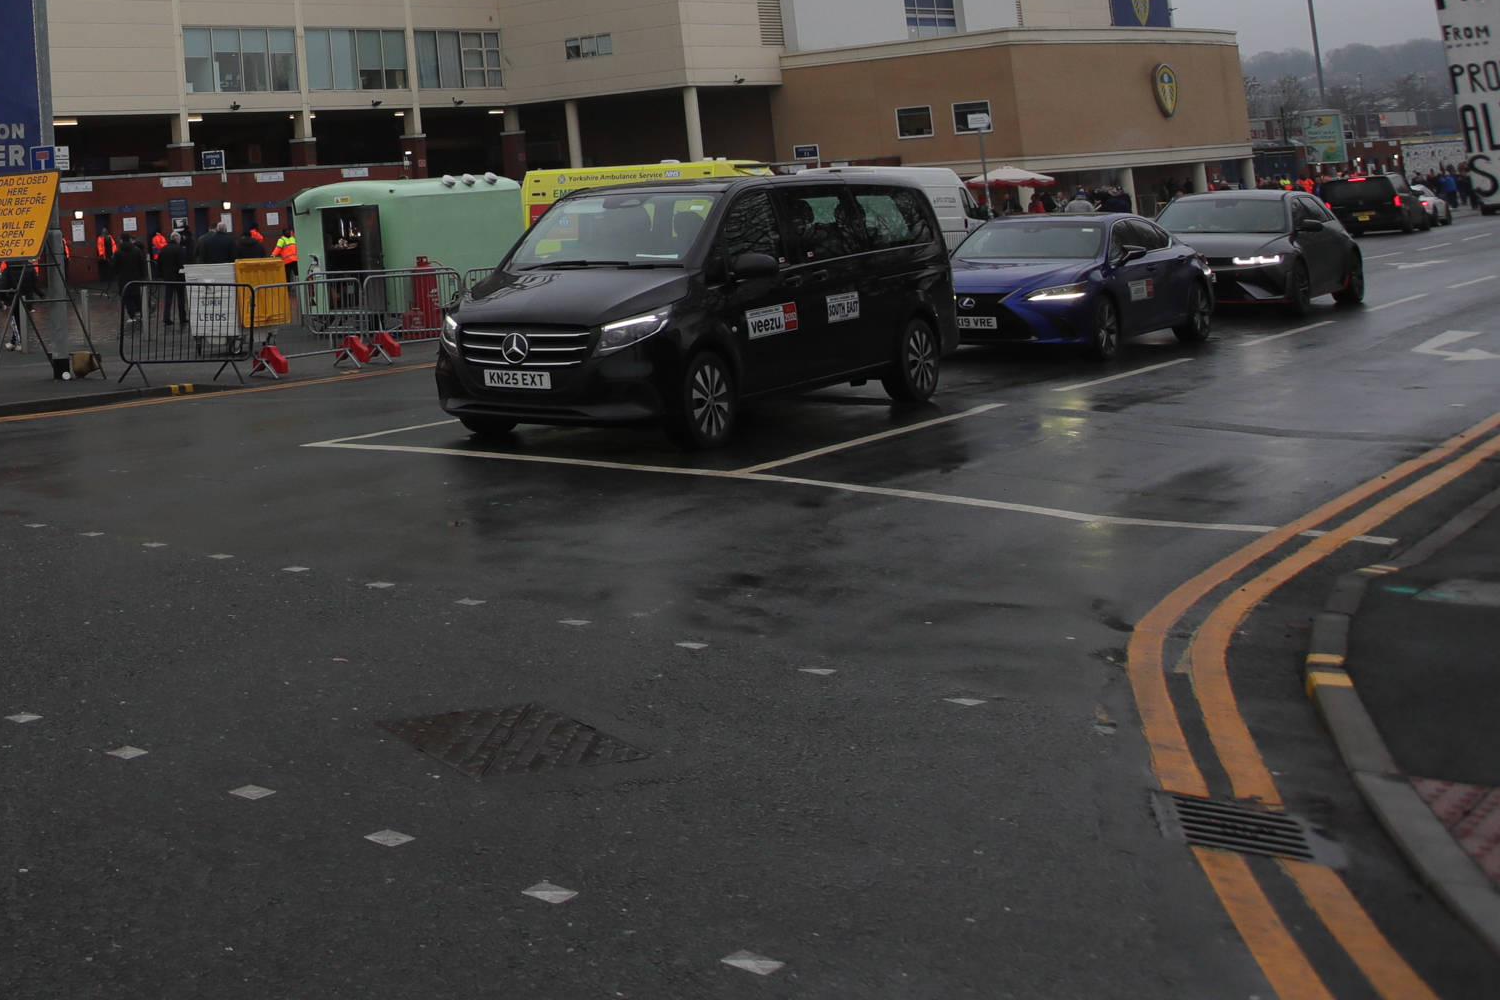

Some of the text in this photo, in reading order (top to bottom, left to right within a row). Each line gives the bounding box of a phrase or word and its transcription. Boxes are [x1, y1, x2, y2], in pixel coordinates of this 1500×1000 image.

[1442, 25, 1490, 42] FROM
[17, 175, 48, 186] CLOSED
[7, 187, 28, 196] HERE
[14, 196, 47, 206] BEFORE
[15, 207, 32, 215] OFF
[2, 221, 21, 230] WILL
[23, 221, 36, 229] BE
[0, 239, 20, 248] SAFE
[23, 239, 34, 247] TO
[0, 249, 12, 257] SO
[828, 301, 859, 317] SOUTH EAST
[199, 313, 228, 322] LEEDS
[973, 319, 993, 328] VRE
[489, 372, 544, 387] KN25 EXT
